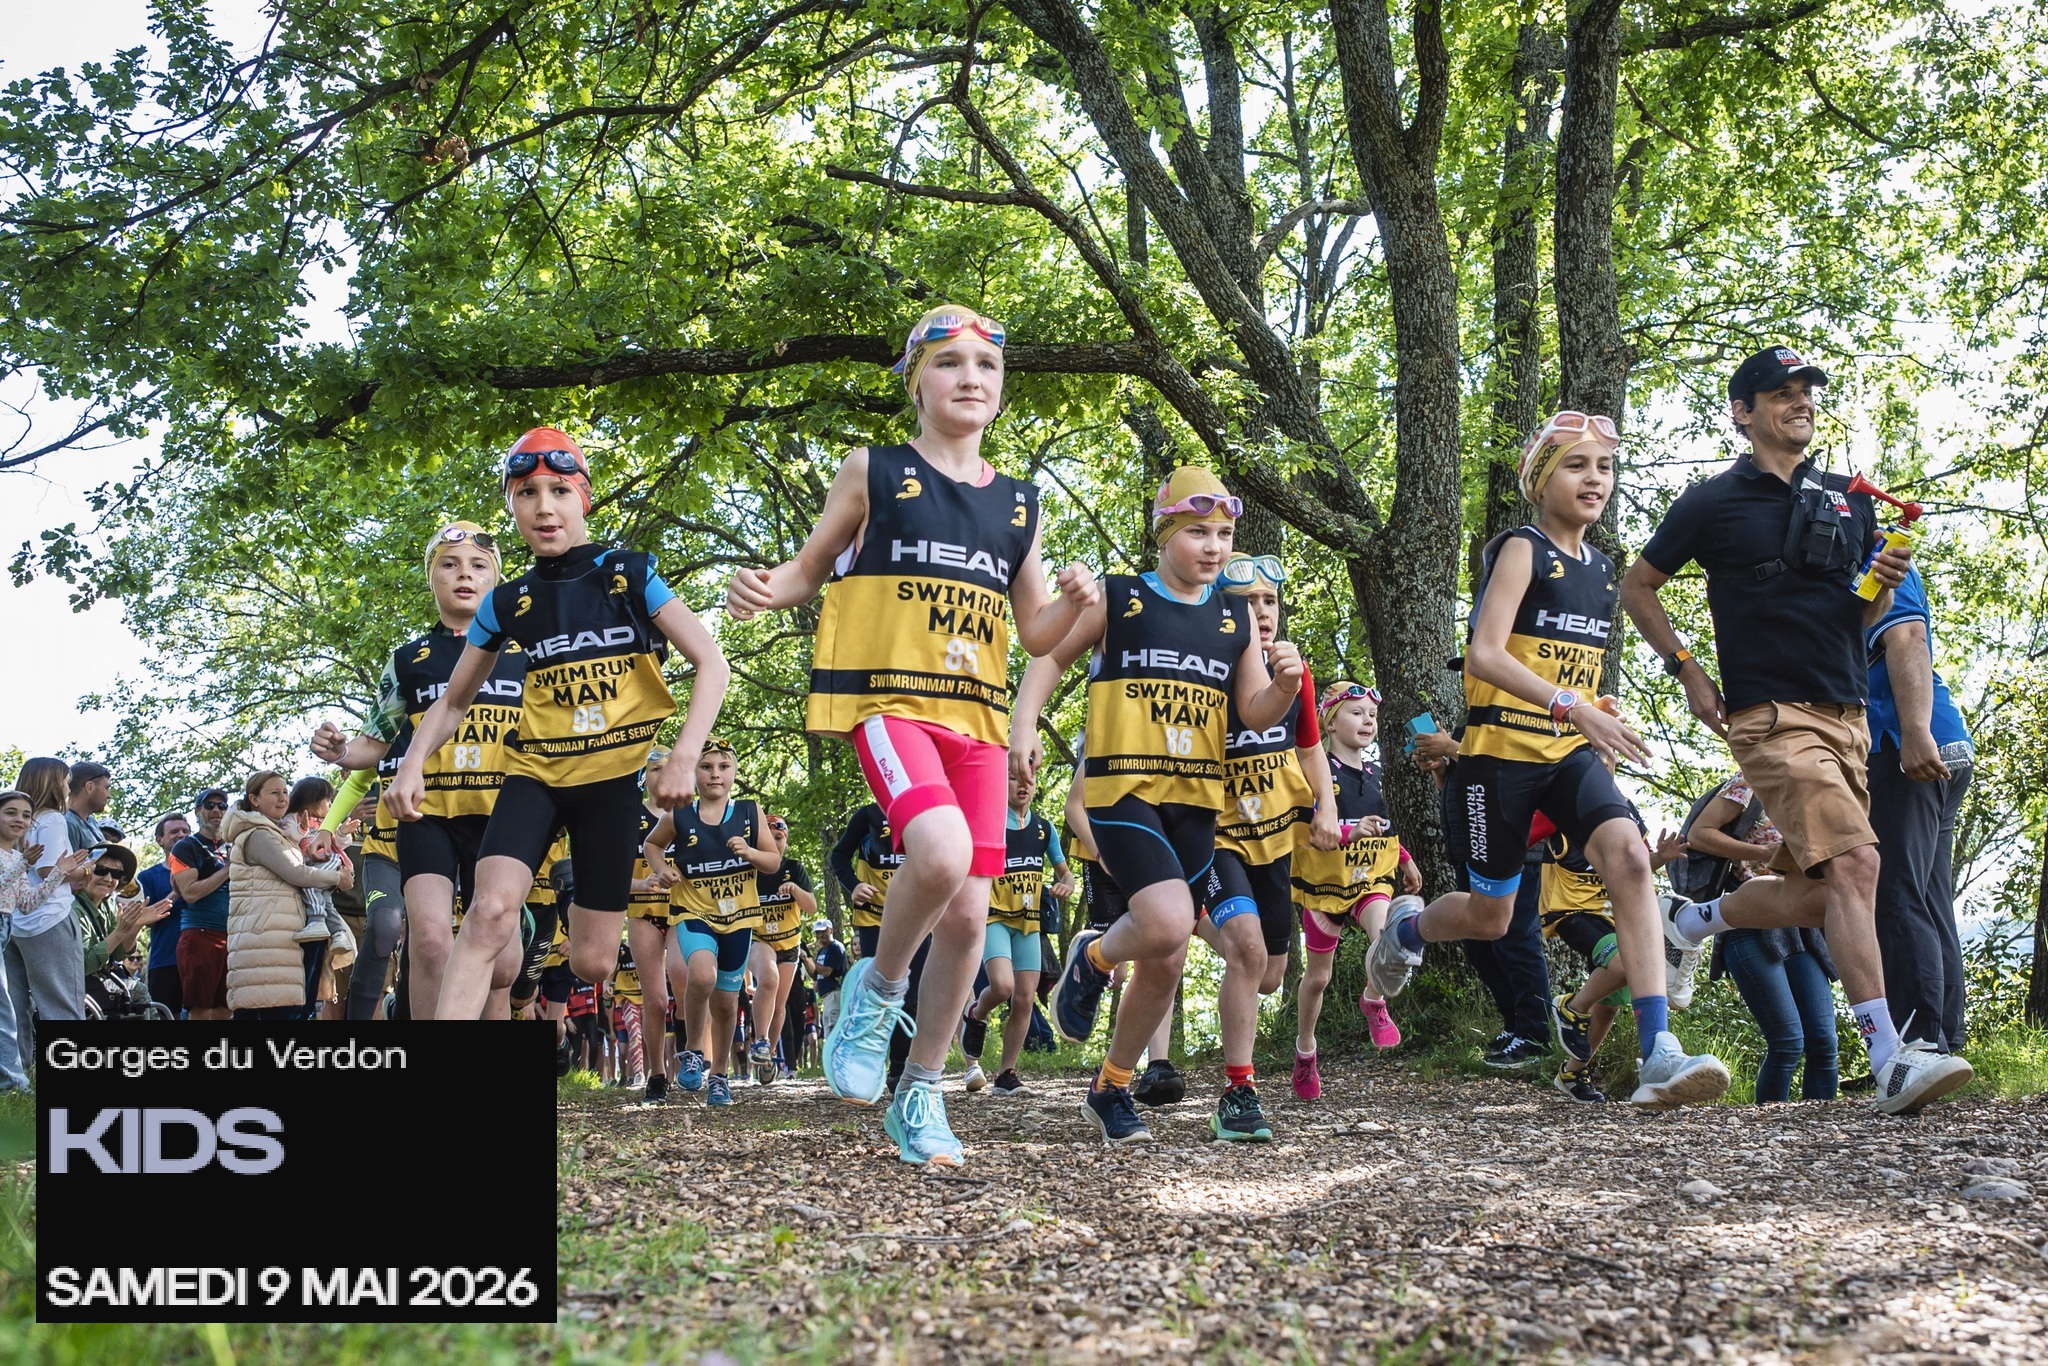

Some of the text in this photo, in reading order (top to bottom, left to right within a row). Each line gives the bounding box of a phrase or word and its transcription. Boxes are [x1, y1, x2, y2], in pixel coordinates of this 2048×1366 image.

[904, 467, 917, 476] 85
[1015, 492, 1026, 502] 85
[1830, 495, 1847, 506] UN
[614, 563, 624, 572] 95
[519, 585, 528, 594] 95
[897, 581, 1007, 620] SWIMRU
[1130, 588, 1139, 597] 86
[1222, 608, 1231, 617] 86
[928, 606, 994, 644] MAN
[523, 625, 635, 663] HEAD
[1537, 642, 1602, 667] SWIMRU
[944, 639, 979, 675] 85
[1121, 648, 1230, 682] HEAD
[533, 656, 636, 689] SWIMRUN
[869, 674, 955, 693] SWIMRUNMAN
[1556, 664, 1596, 688] MAN
[553, 679, 617, 707] MAN
[1125, 683, 1228, 711] SWIMRUN
[572, 705, 606, 733] 95
[1151, 703, 1210, 728] MAN
[1165, 727, 1194, 755] 86
[1224, 725, 1287, 750] AD
[454, 745, 482, 769] 83
[1108, 758, 1174, 772] SWIMRUNMAN
[1223, 752, 1290, 778] IMRUN
[1236, 796, 1263, 821] 92
[1466, 784, 1480, 861] TRIATHLON
[1475, 784, 1488, 863] CHAMPIGNY
[879, 854, 906, 864] HE
[693, 870, 755, 889] SWIMRUN
[710, 883, 744, 900] MAN
[717, 897, 736, 915] 85
[758, 893, 791, 903] EAD
[762, 904, 792, 914] IMRUN
[1214, 903, 1235, 925] POLI
[765, 921, 779, 934] 93
